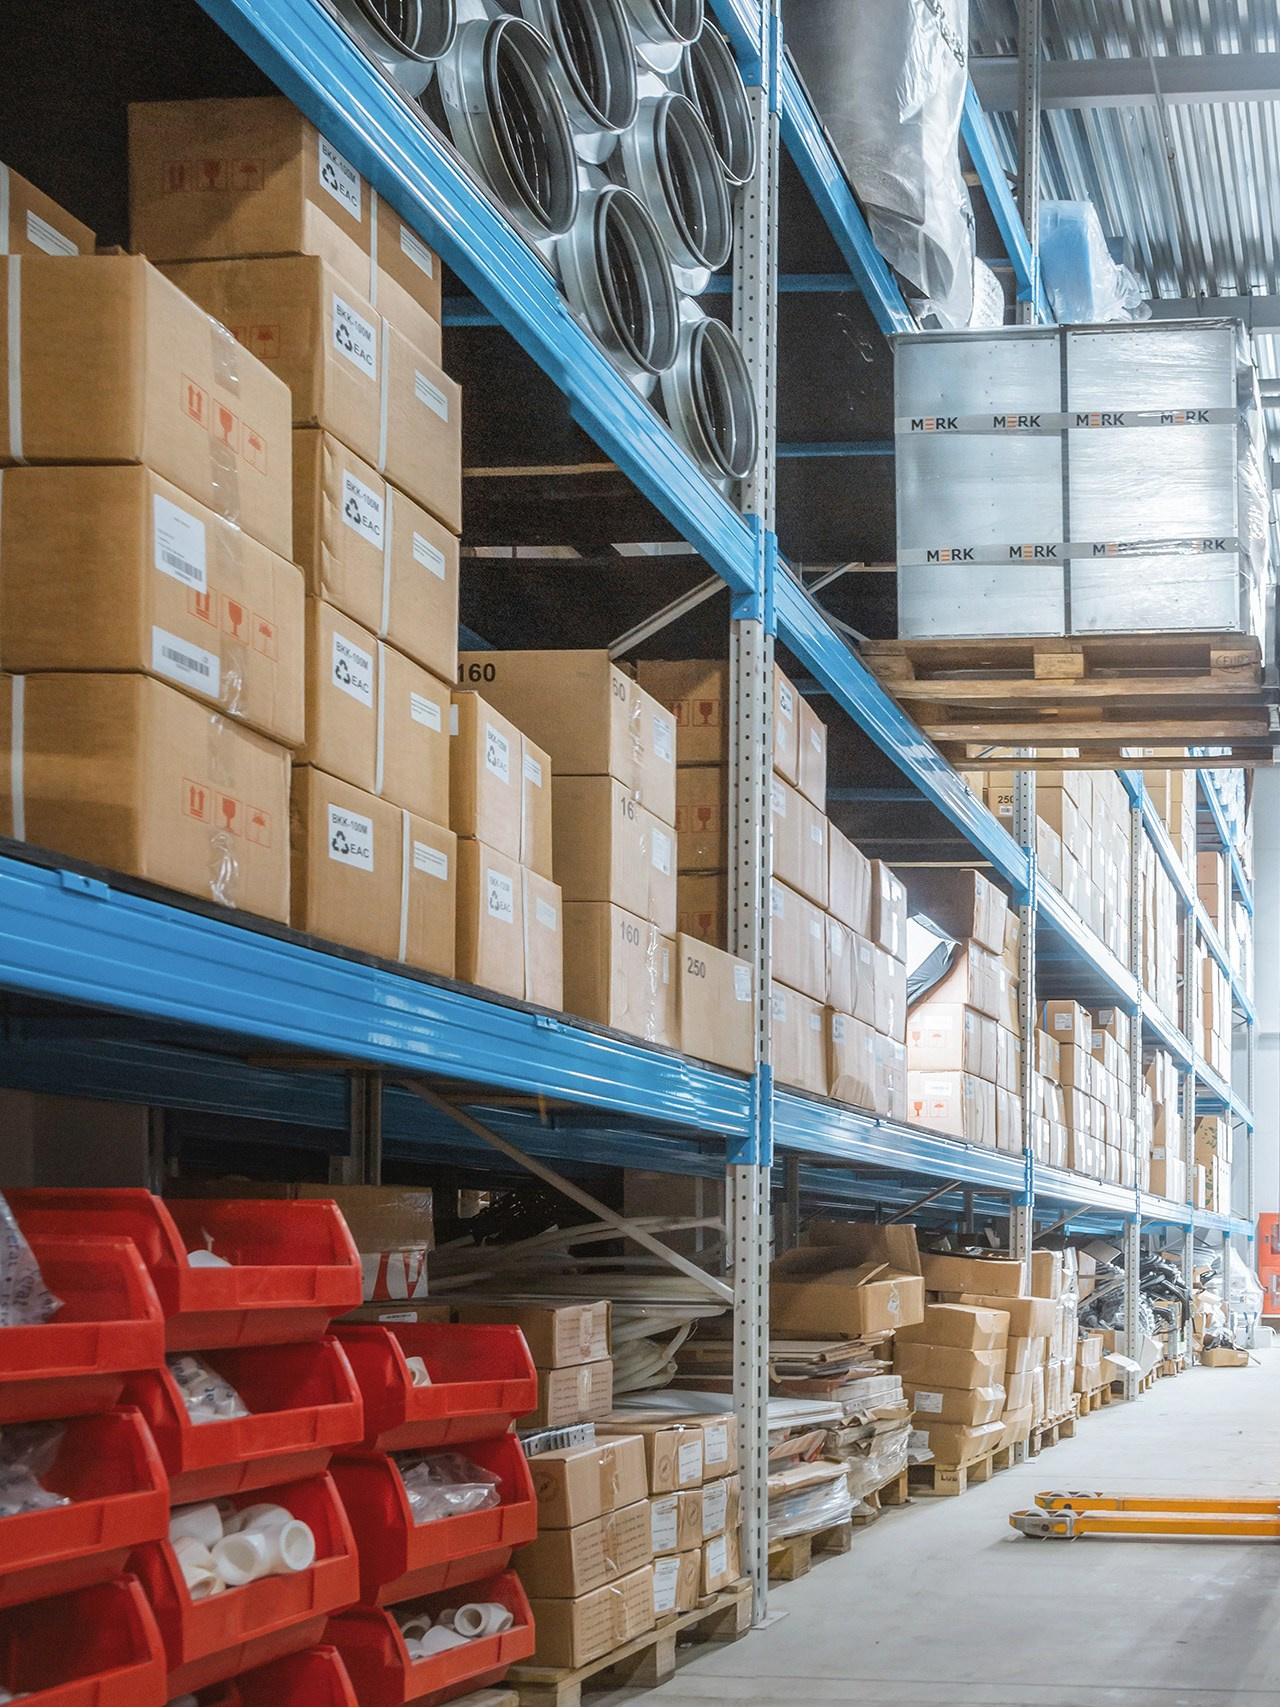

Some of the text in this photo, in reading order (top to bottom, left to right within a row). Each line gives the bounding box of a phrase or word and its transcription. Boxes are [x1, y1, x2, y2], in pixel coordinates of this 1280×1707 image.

[339, 183, 358, 207] EAC
[353, 343, 373, 366] EAC
[911, 417, 959, 431] MERK
[993, 415, 1041, 428] MERK
[1076, 413, 1125, 427] MERK
[362, 515, 380, 536] EAC
[926, 547, 975, 562] MERK
[1009, 544, 1058, 558] MERK
[457, 663, 497, 683] 160
[351, 674, 369, 694] EAC
[350, 843, 370, 859] EAC
[620, 921, 640, 947] 160
[687, 956, 706, 979] 250
